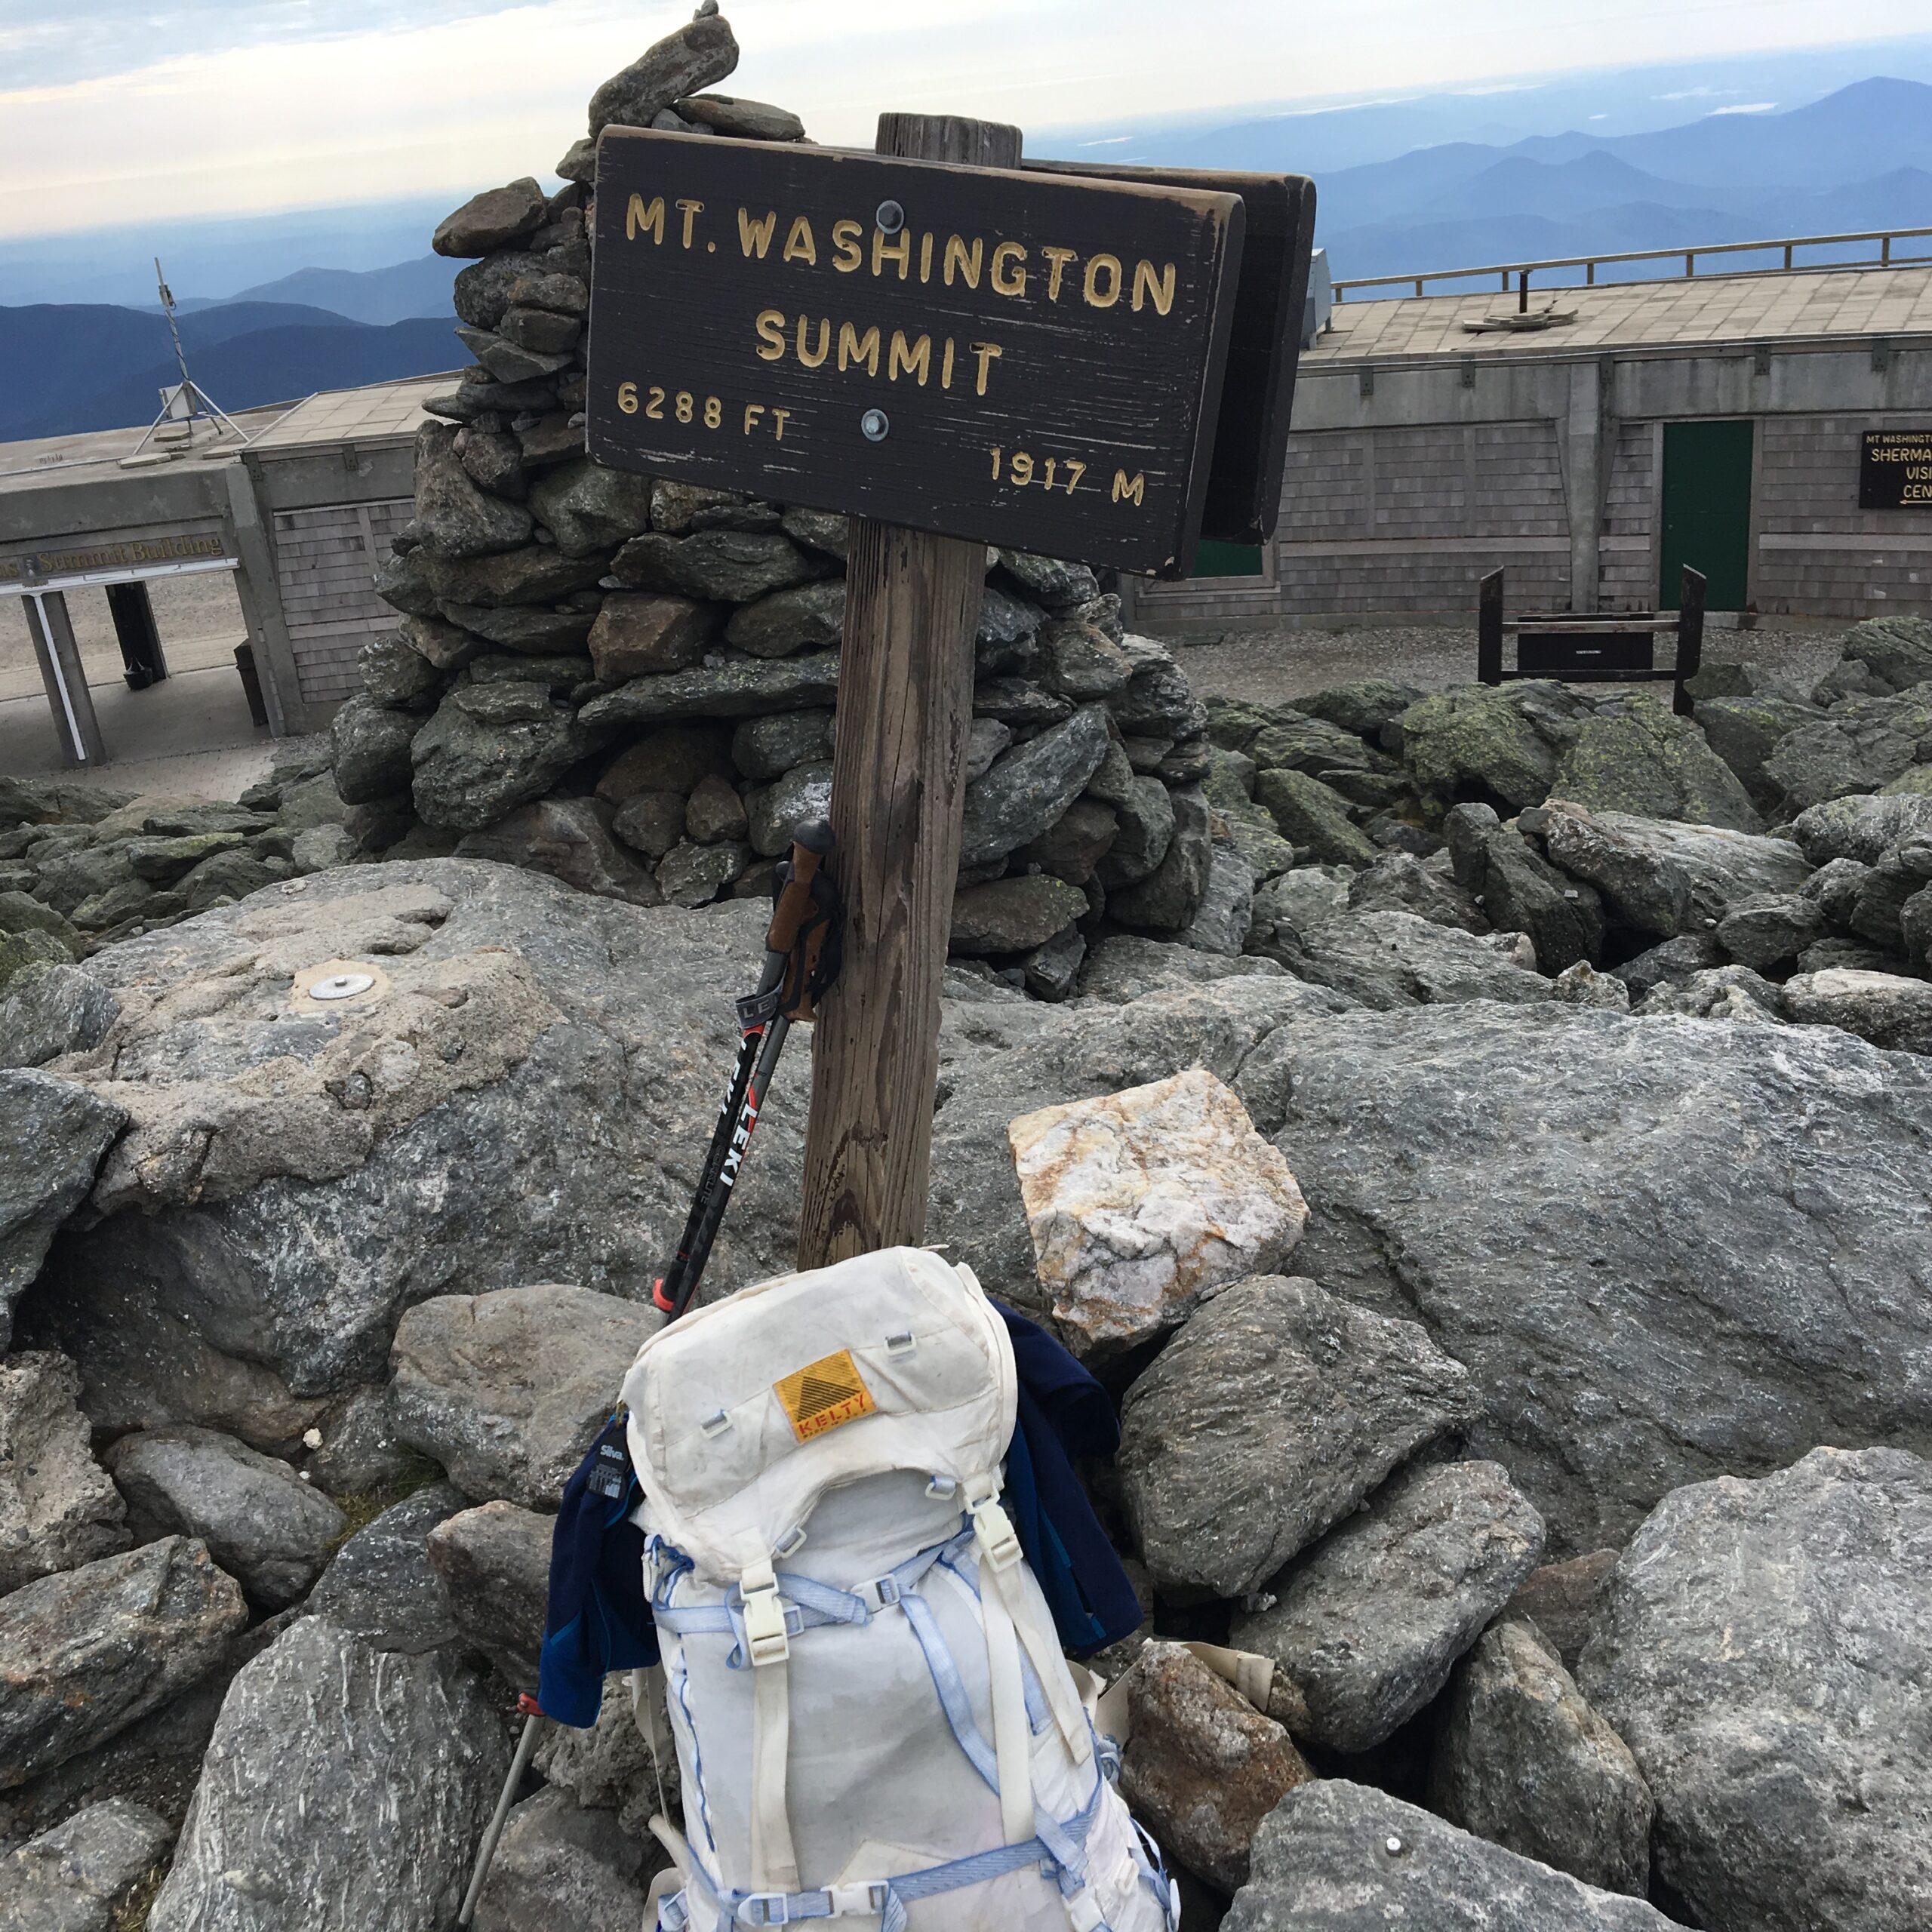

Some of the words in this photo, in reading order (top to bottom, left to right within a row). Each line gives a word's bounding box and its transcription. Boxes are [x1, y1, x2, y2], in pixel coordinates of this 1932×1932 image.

[626, 194, 716, 253] MT.
[737, 207, 1176, 316] WASHINGTON
[755, 309, 1002, 395] SUMMIT
[618, 381, 721, 429] 6288
[743, 404, 791, 441] FT
[1866, 435, 1880, 444] MT
[1871, 448, 1932, 462] SHERMA
[991, 447, 1085, 494] 1917
[1112, 469, 1145, 506] M
[1903, 484, 1932, 498] CEN
[38, 543, 127, 573] Summit
[129, 534, 223, 562] Building
[718, 1103, 758, 1187] LEKI
[798, 1394, 865, 1435] KELTY
